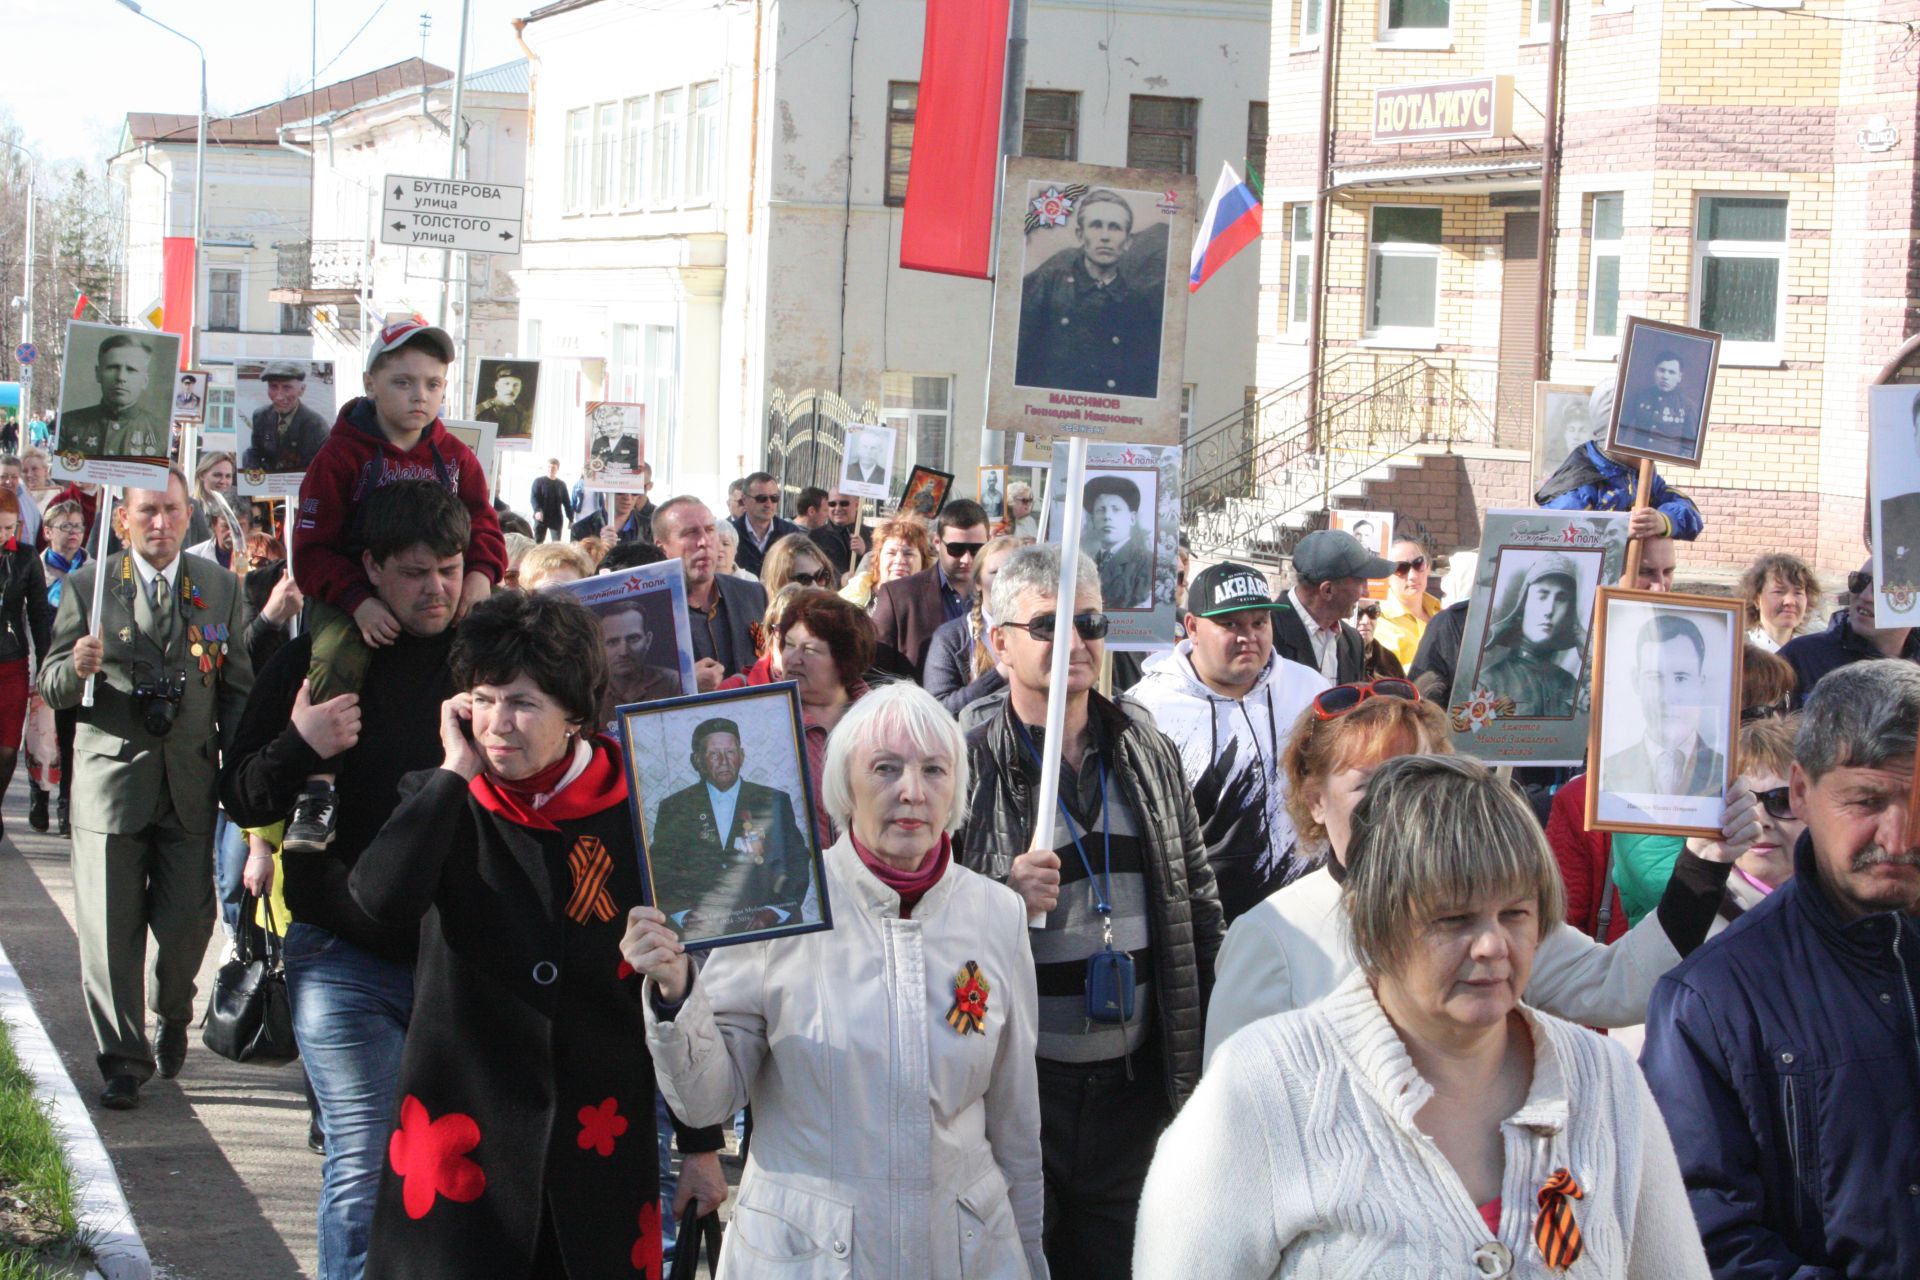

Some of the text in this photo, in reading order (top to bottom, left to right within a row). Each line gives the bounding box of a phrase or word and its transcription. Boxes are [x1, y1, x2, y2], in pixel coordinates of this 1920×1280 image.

[1377, 87, 1490, 133] НОТАРИУС
[413, 180, 502, 199] БУТЛЕРОВА
[414, 197, 458, 209] улица
[412, 213, 491, 232] ТОЛСТОГО
[412, 231, 455, 243] улица
[1049, 393, 1121, 410] МАКСИМОВ
[1024, 404, 1143, 426] Геннадий Иванович
[122, 556, 131, 579] Nikon
[1214, 576, 1270, 605] AKBARS
